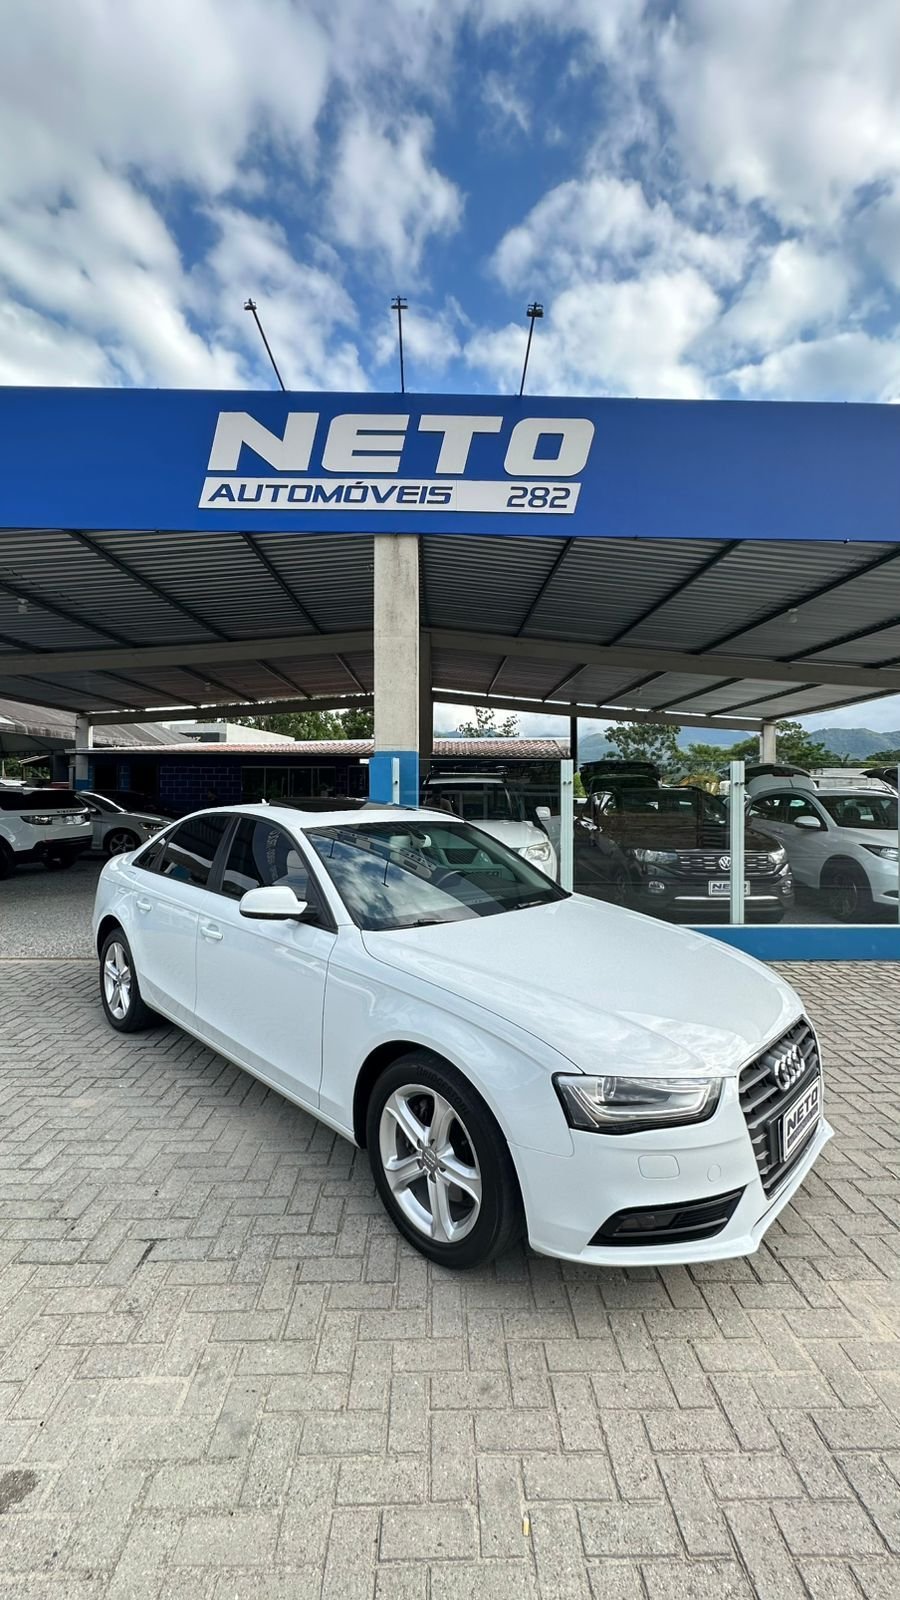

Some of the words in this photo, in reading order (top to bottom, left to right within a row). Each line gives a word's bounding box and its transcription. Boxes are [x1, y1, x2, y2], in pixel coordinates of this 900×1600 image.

[207, 411, 595, 477] NETO
[207, 480, 453, 505] AUTOMÓVEIS
[506, 486, 571, 509] 282
[787, 1086, 818, 1137] NETO
